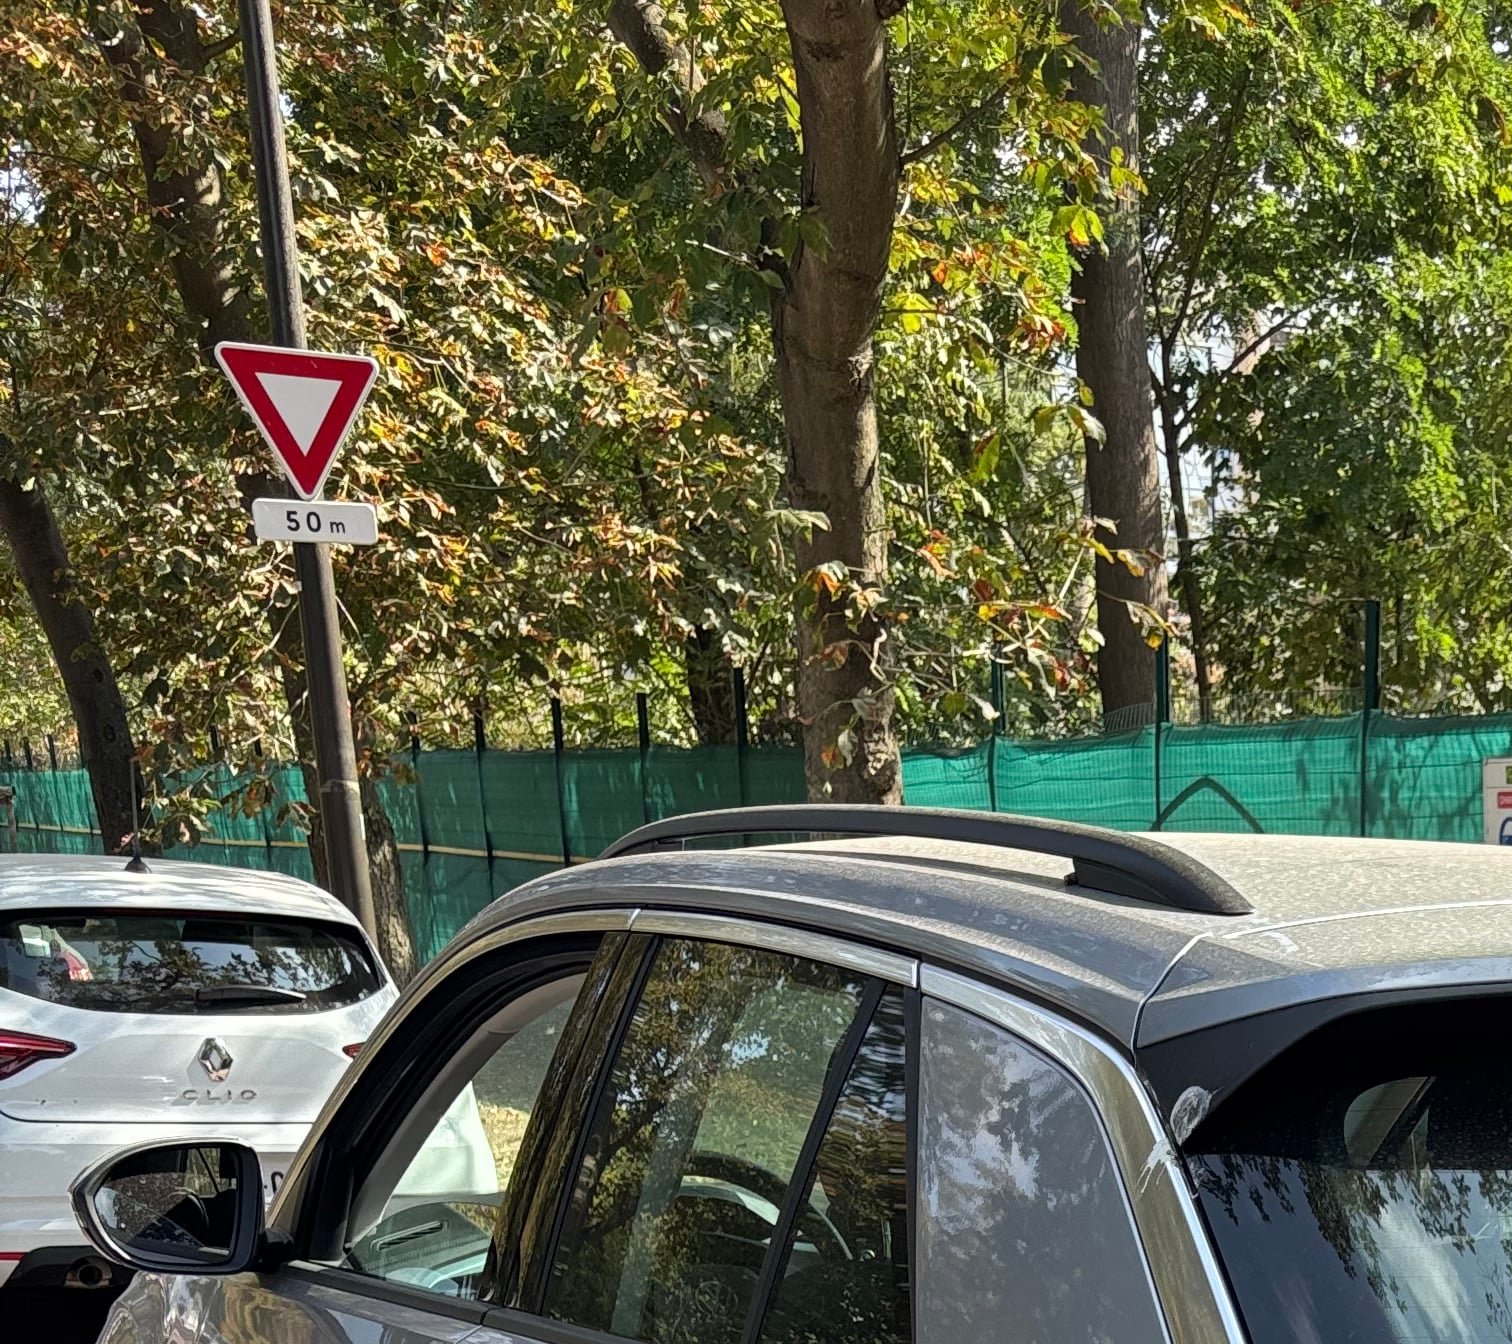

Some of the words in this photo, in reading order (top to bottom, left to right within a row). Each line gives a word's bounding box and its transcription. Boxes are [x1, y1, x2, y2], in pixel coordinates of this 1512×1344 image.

[286, 510, 321, 533] 50
[329, 521, 346, 534] m
[182, 1089, 257, 1100] CLIO
